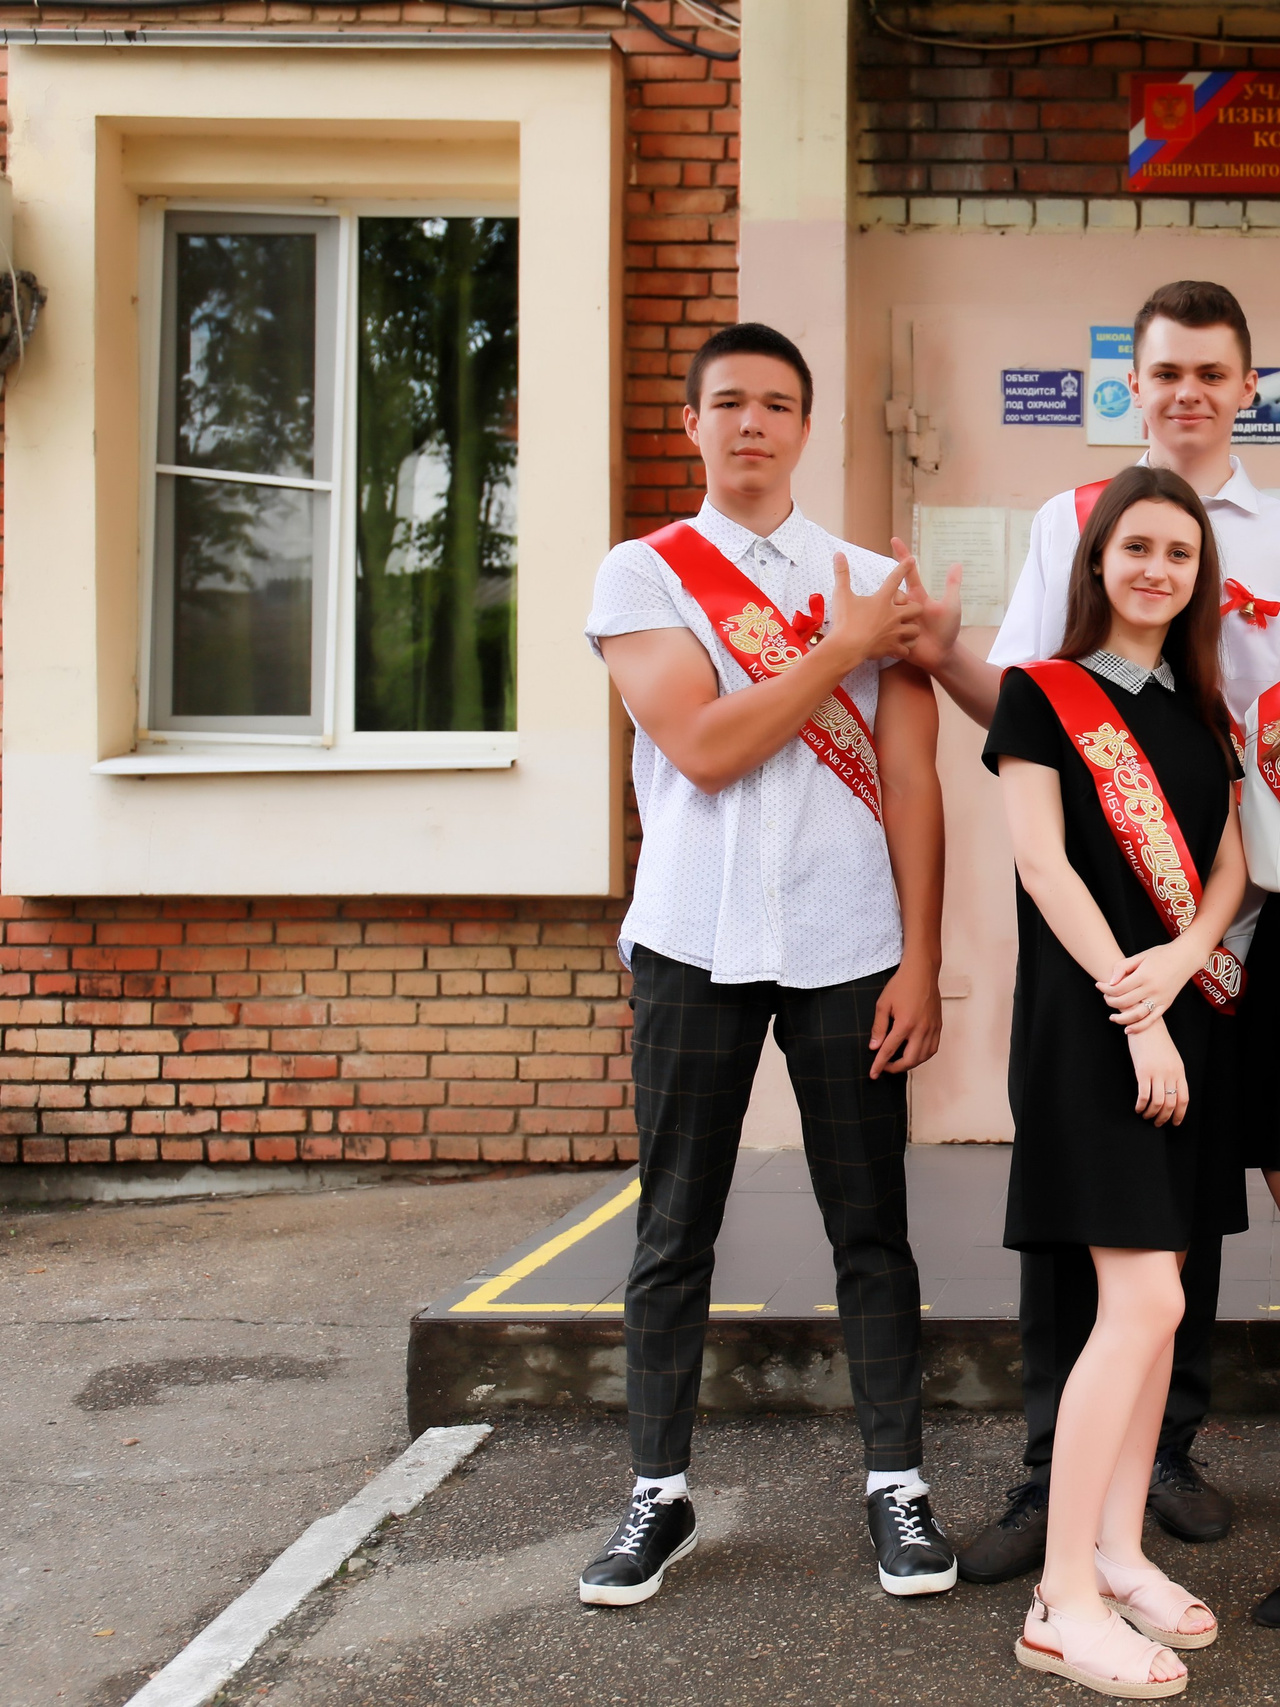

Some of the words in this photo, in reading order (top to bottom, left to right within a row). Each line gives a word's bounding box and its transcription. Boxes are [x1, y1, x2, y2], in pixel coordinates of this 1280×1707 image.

[1142, 163, 1280, 178] ИЗБИРАТЕЛЬНОГО
[1096, 333, 1132, 342] ШКОЛА
[1005, 374, 1040, 382] ОБЪЕКТ
[1005, 387, 1056, 396] НАХОДИТСЯ
[1005, 401, 1024, 410] ПОД
[1027, 400, 1067, 409] ОХРАНОЙ
[1020, 414, 1034, 422] ЧОП
[824, 748, 854, 779] №12
[1102, 781, 1131, 833] МБОУ
[1203, 951, 1242, 997] 020
